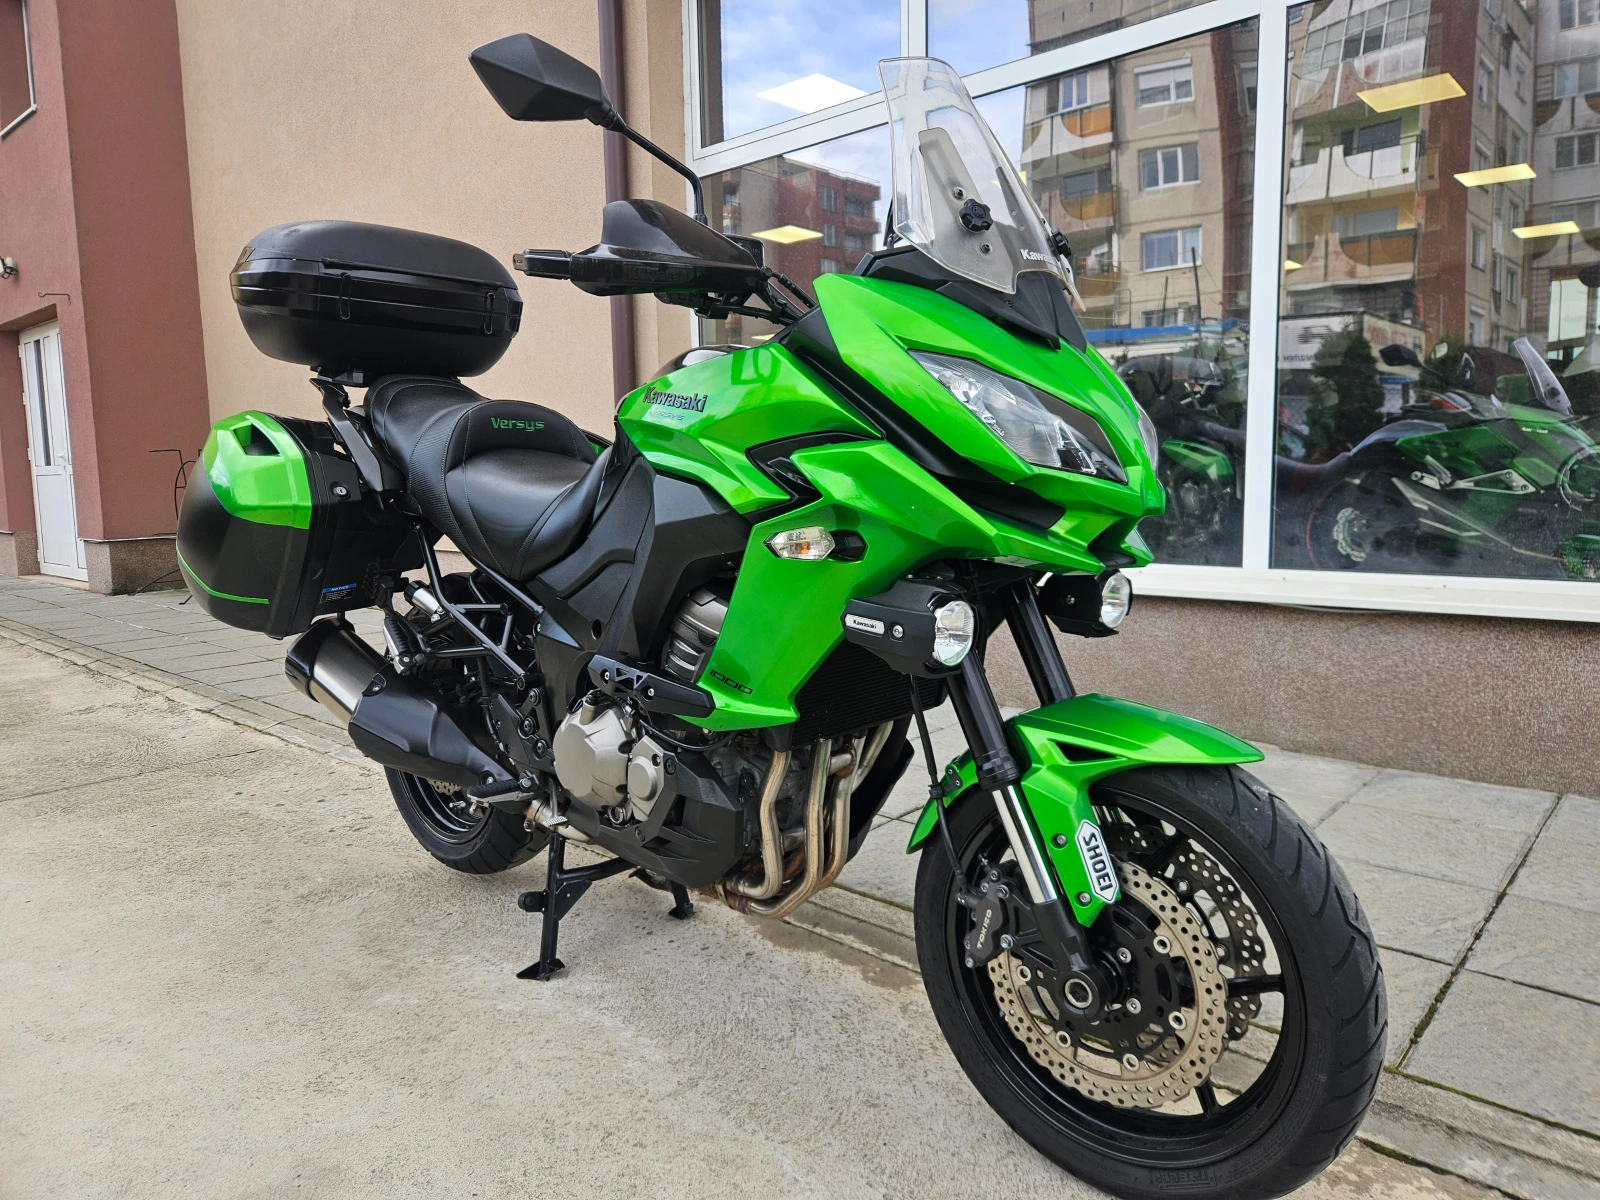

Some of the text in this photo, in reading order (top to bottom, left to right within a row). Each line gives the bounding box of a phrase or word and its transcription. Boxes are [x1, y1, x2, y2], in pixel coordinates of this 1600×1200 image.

[642, 386, 708, 412] Kawasaki
[490, 417, 545, 432] Versys
[853, 619, 877, 629] Kawasaki
[710, 669, 753, 695] 1000
[1082, 832, 1113, 892] SHOEI
[976, 909, 992, 949] TOKICO
